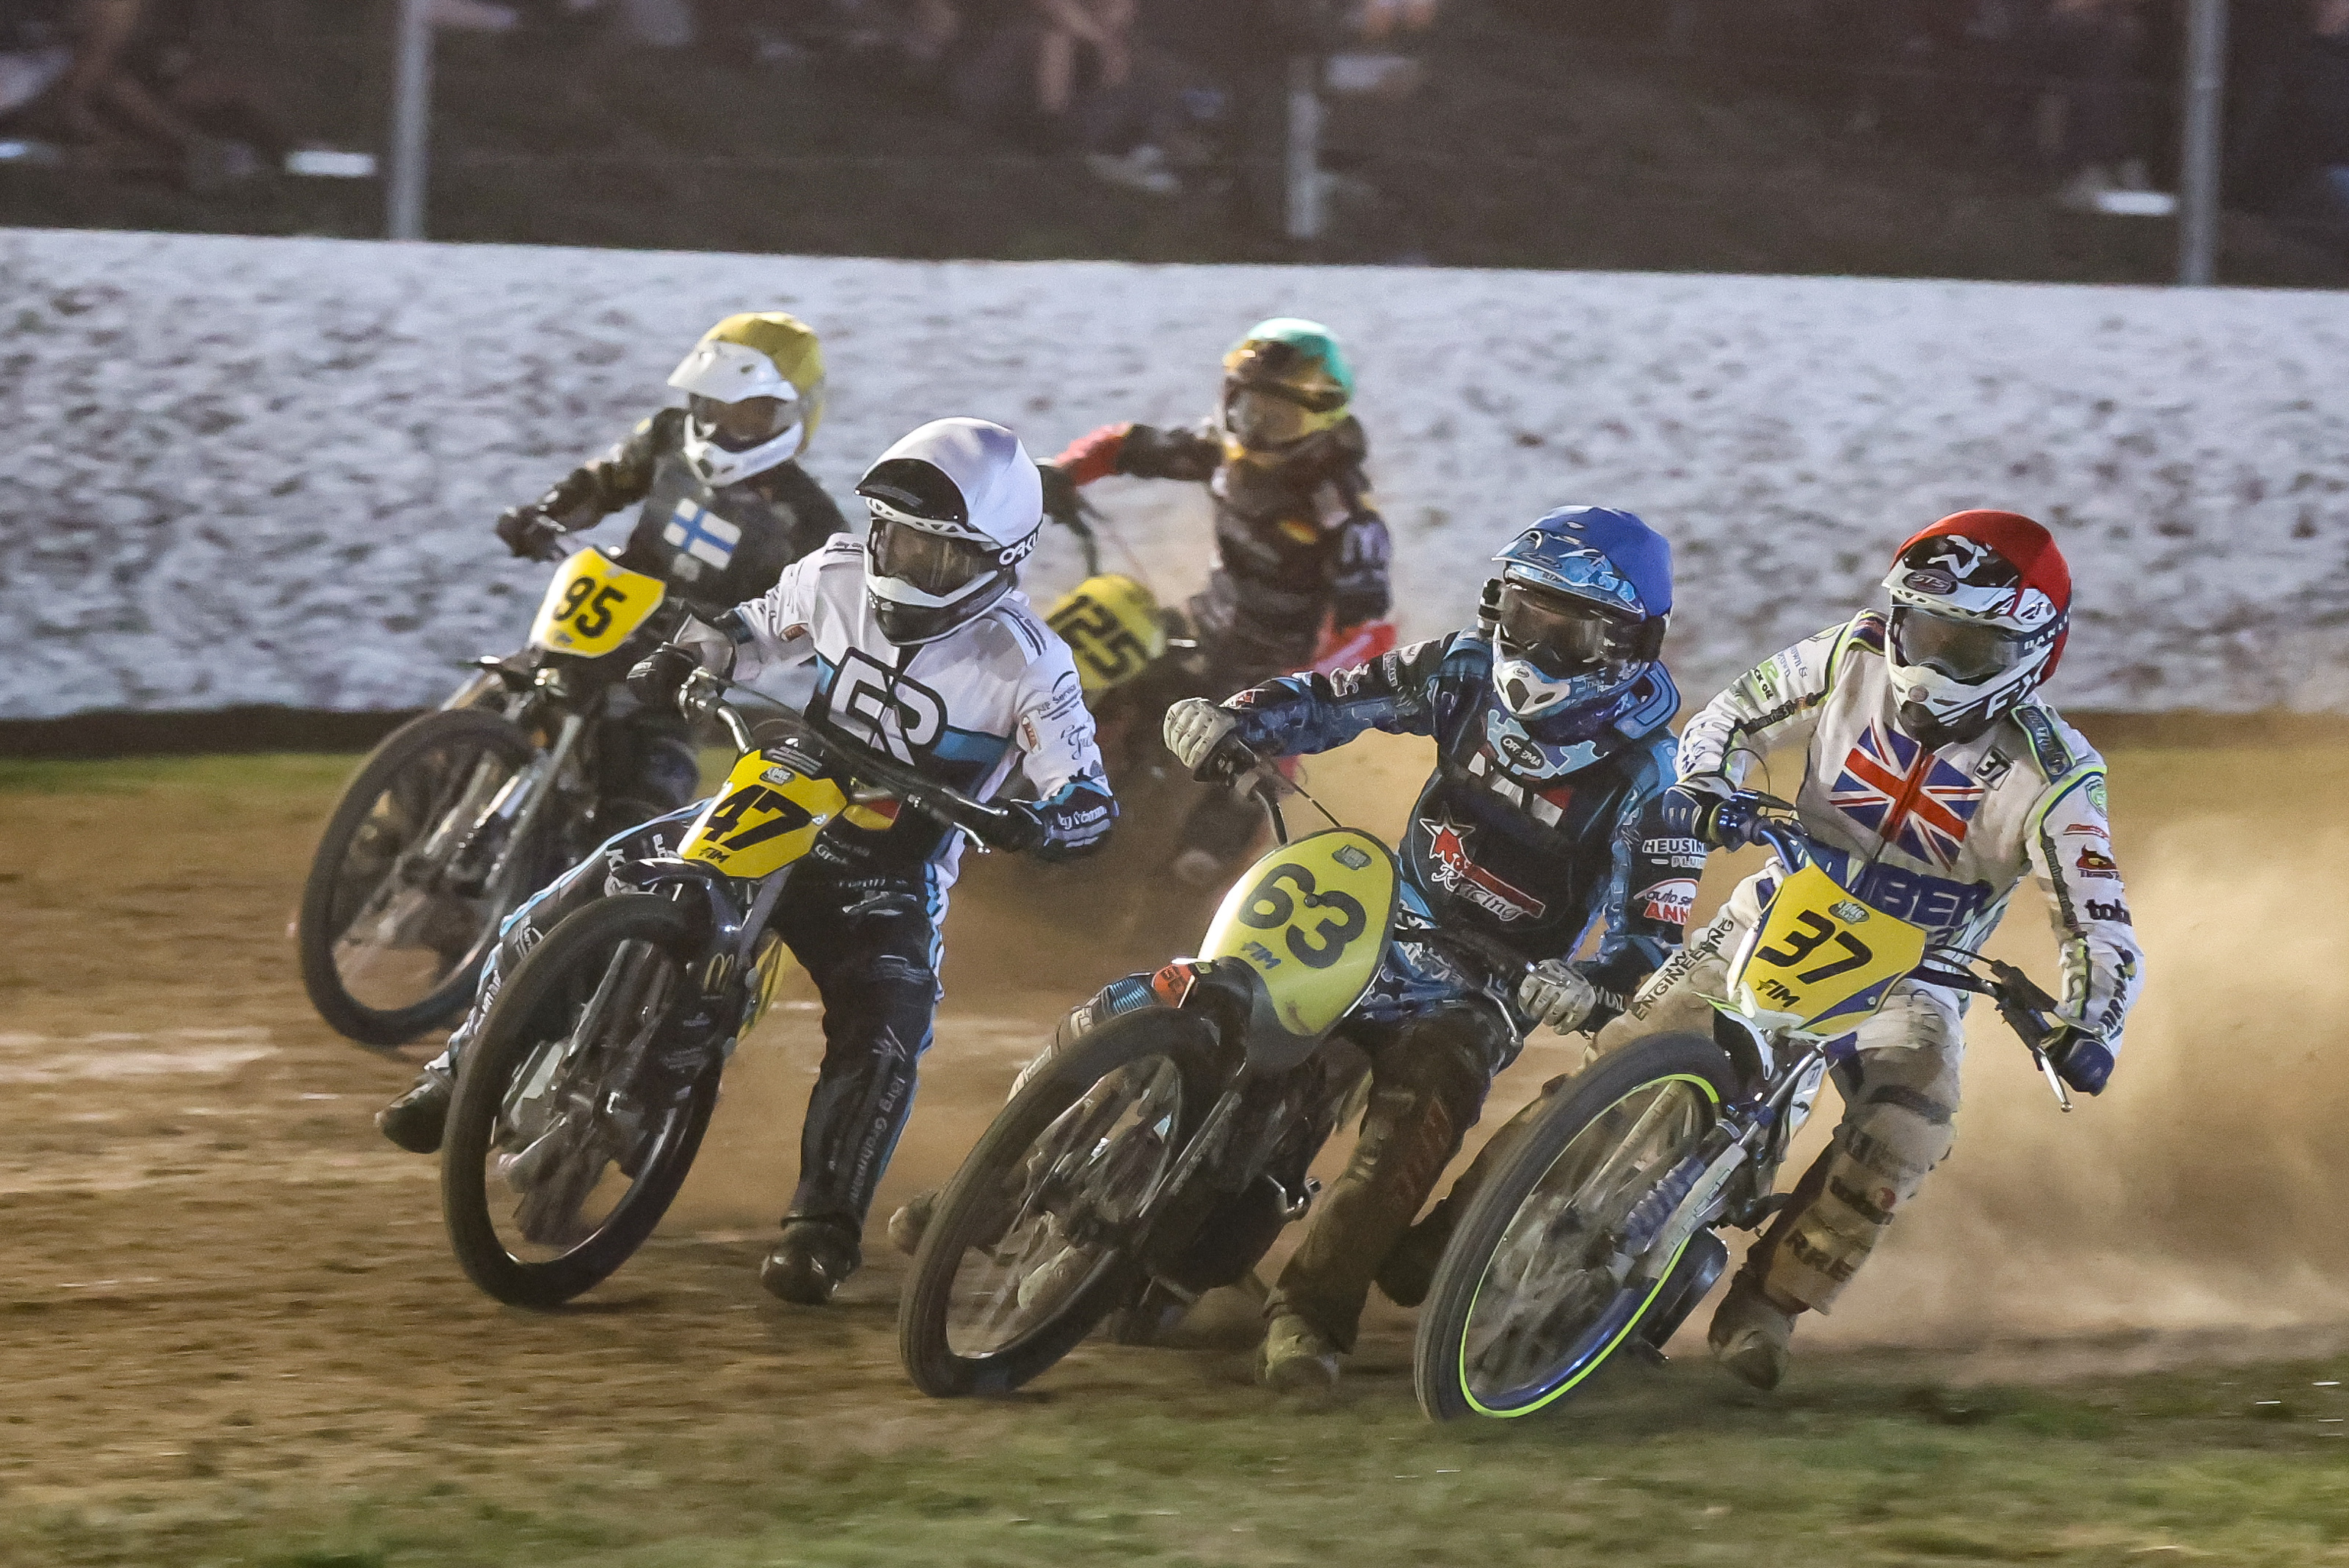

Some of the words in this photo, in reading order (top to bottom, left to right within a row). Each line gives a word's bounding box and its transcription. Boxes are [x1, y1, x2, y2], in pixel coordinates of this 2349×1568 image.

[553, 577, 628, 639] 95
[1502, 738, 1542, 766] OREMA
[1976, 749, 2011, 783] 37
[702, 784, 813, 852] 47
[698, 847, 730, 863] FIM
[1238, 863, 1367, 969] 63
[1755, 909, 1873, 984] 37
[1757, 979, 1801, 1008] FIM
